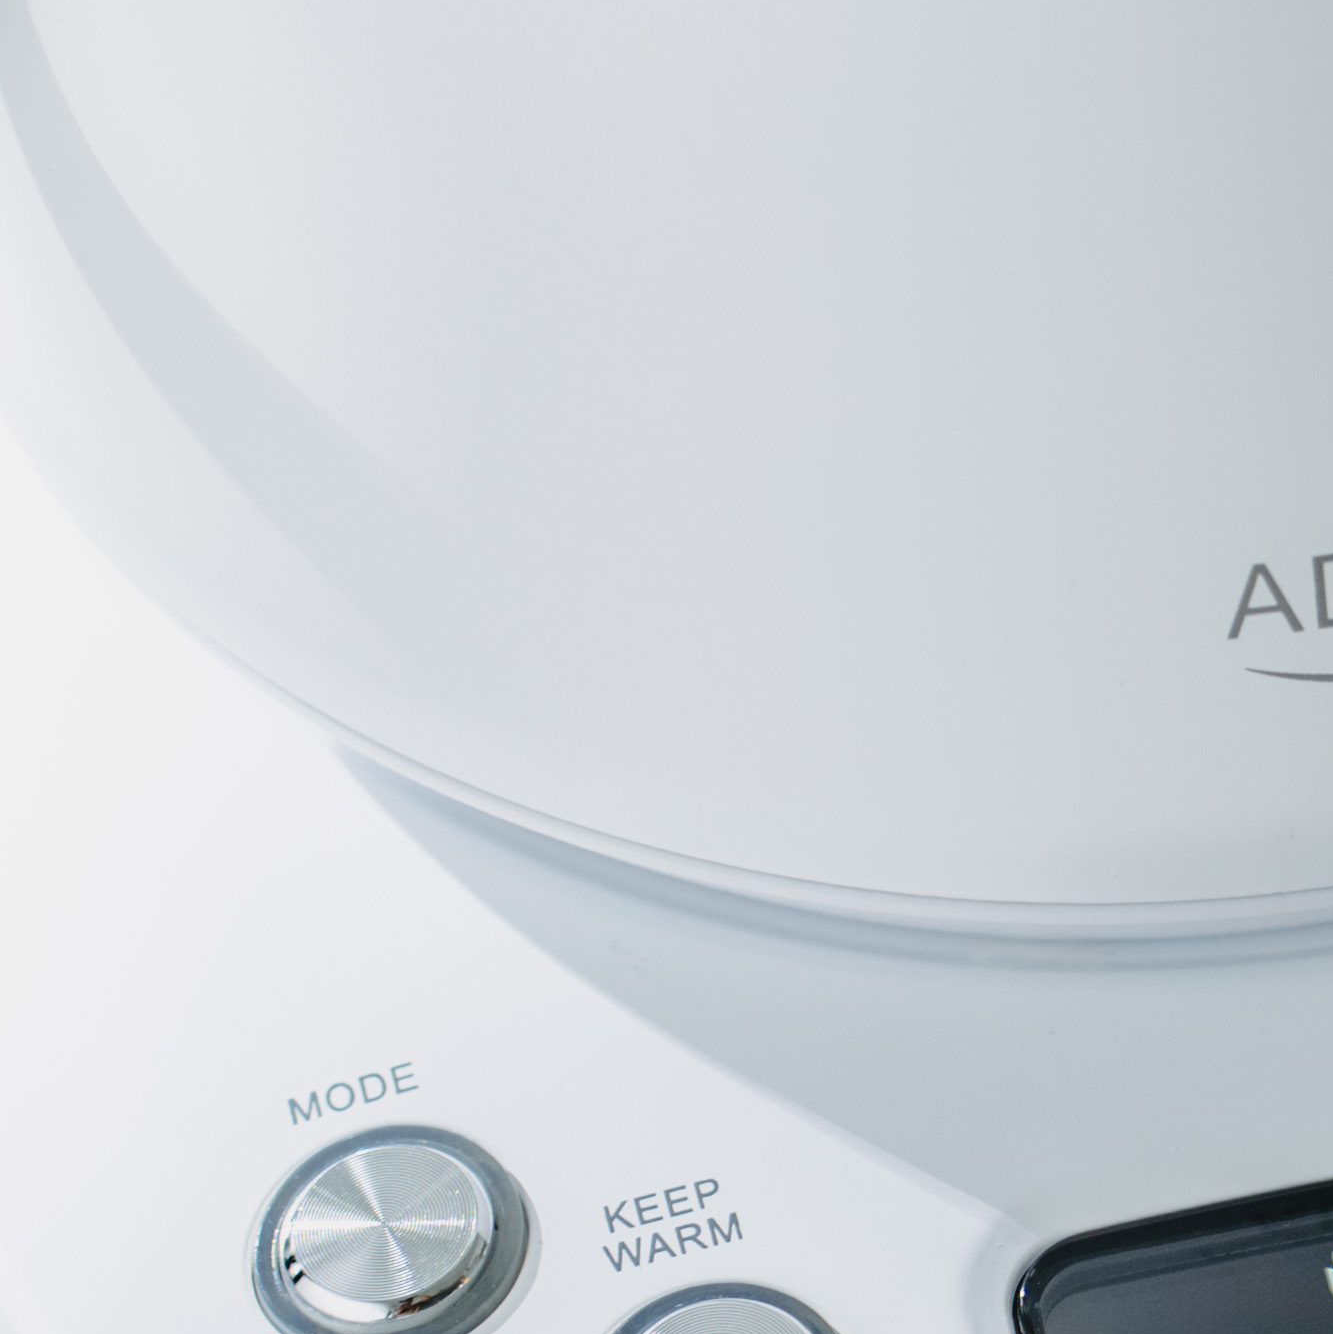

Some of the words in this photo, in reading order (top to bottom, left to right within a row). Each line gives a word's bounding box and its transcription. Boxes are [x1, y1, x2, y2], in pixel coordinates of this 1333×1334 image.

[287, 1062, 419, 1124] MODE
[602, 1178, 722, 1233] KEEP
[603, 1212, 743, 1272] WARM
